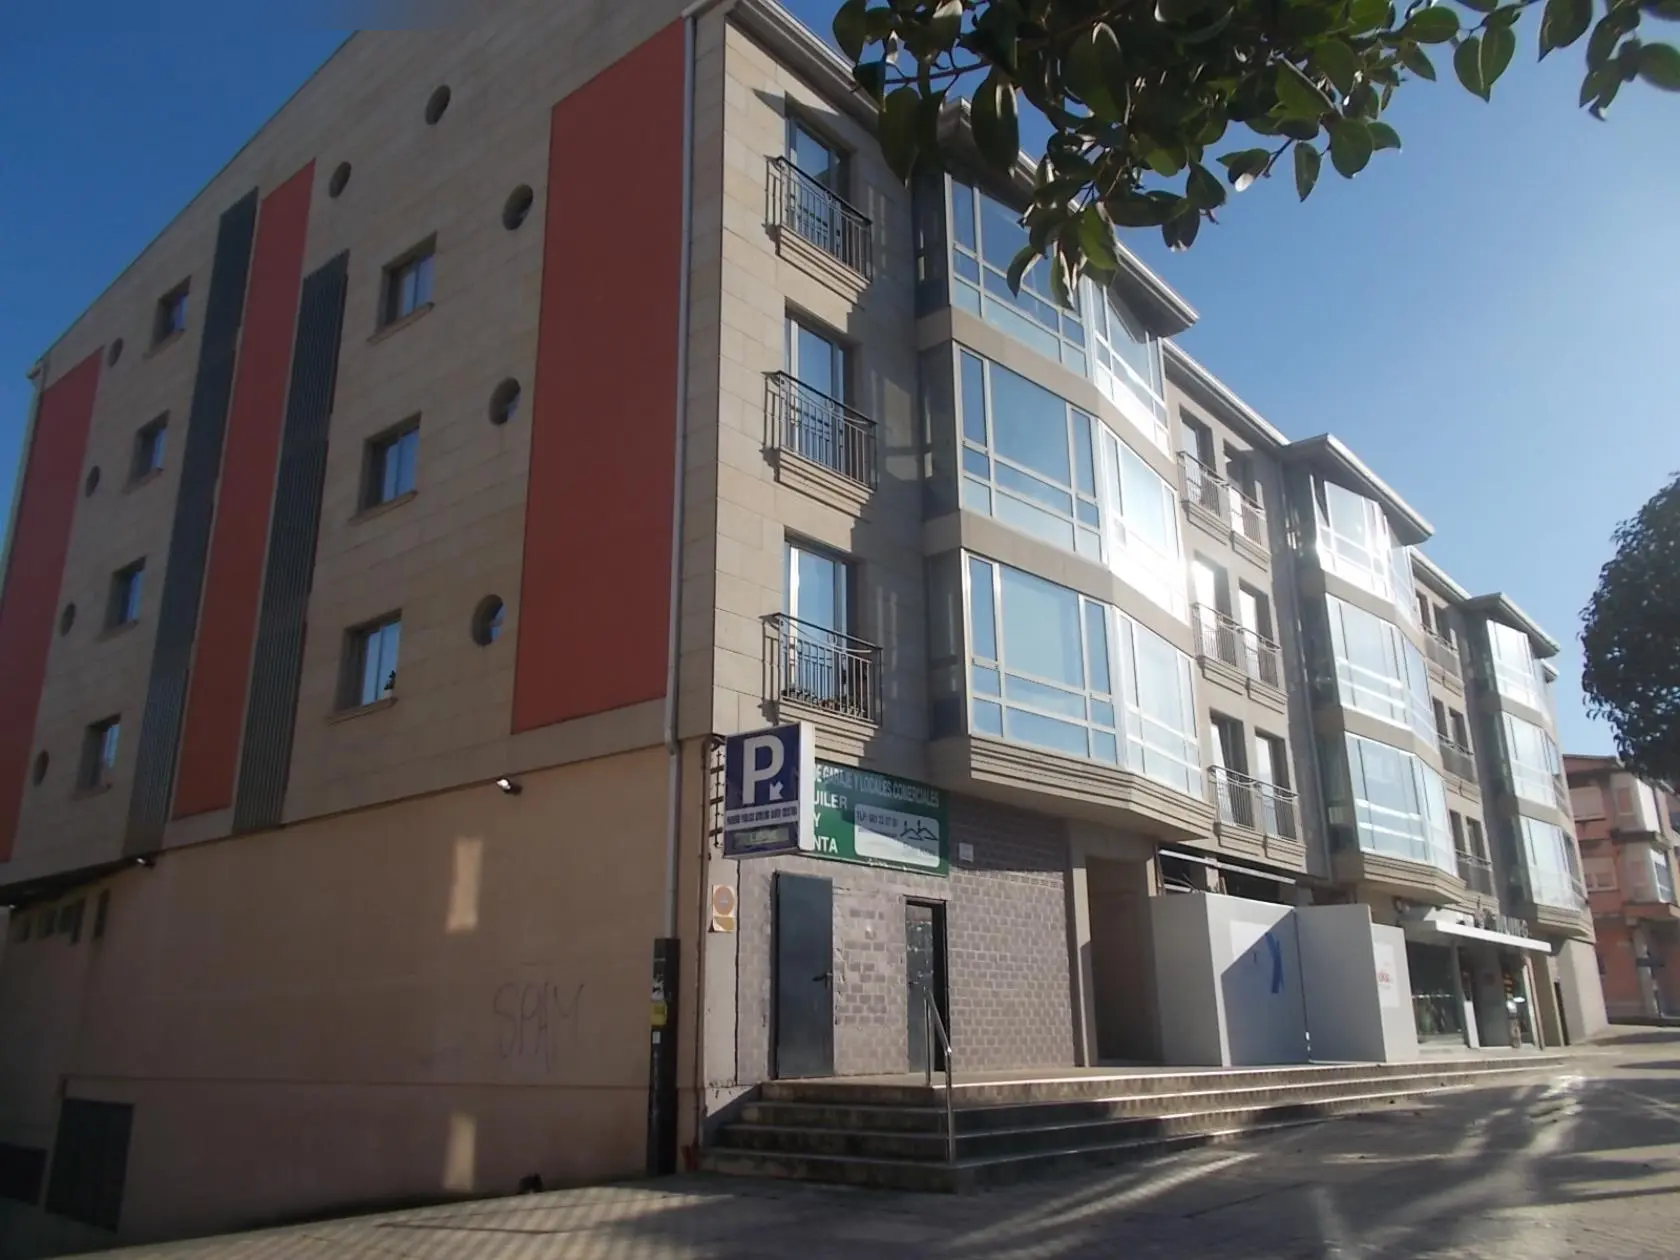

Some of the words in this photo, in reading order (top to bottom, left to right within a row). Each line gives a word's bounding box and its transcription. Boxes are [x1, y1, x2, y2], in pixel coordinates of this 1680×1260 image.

[743, 735, 784, 804] P
[814, 789, 848, 809] UILER
[814, 836, 839, 854] NTA
